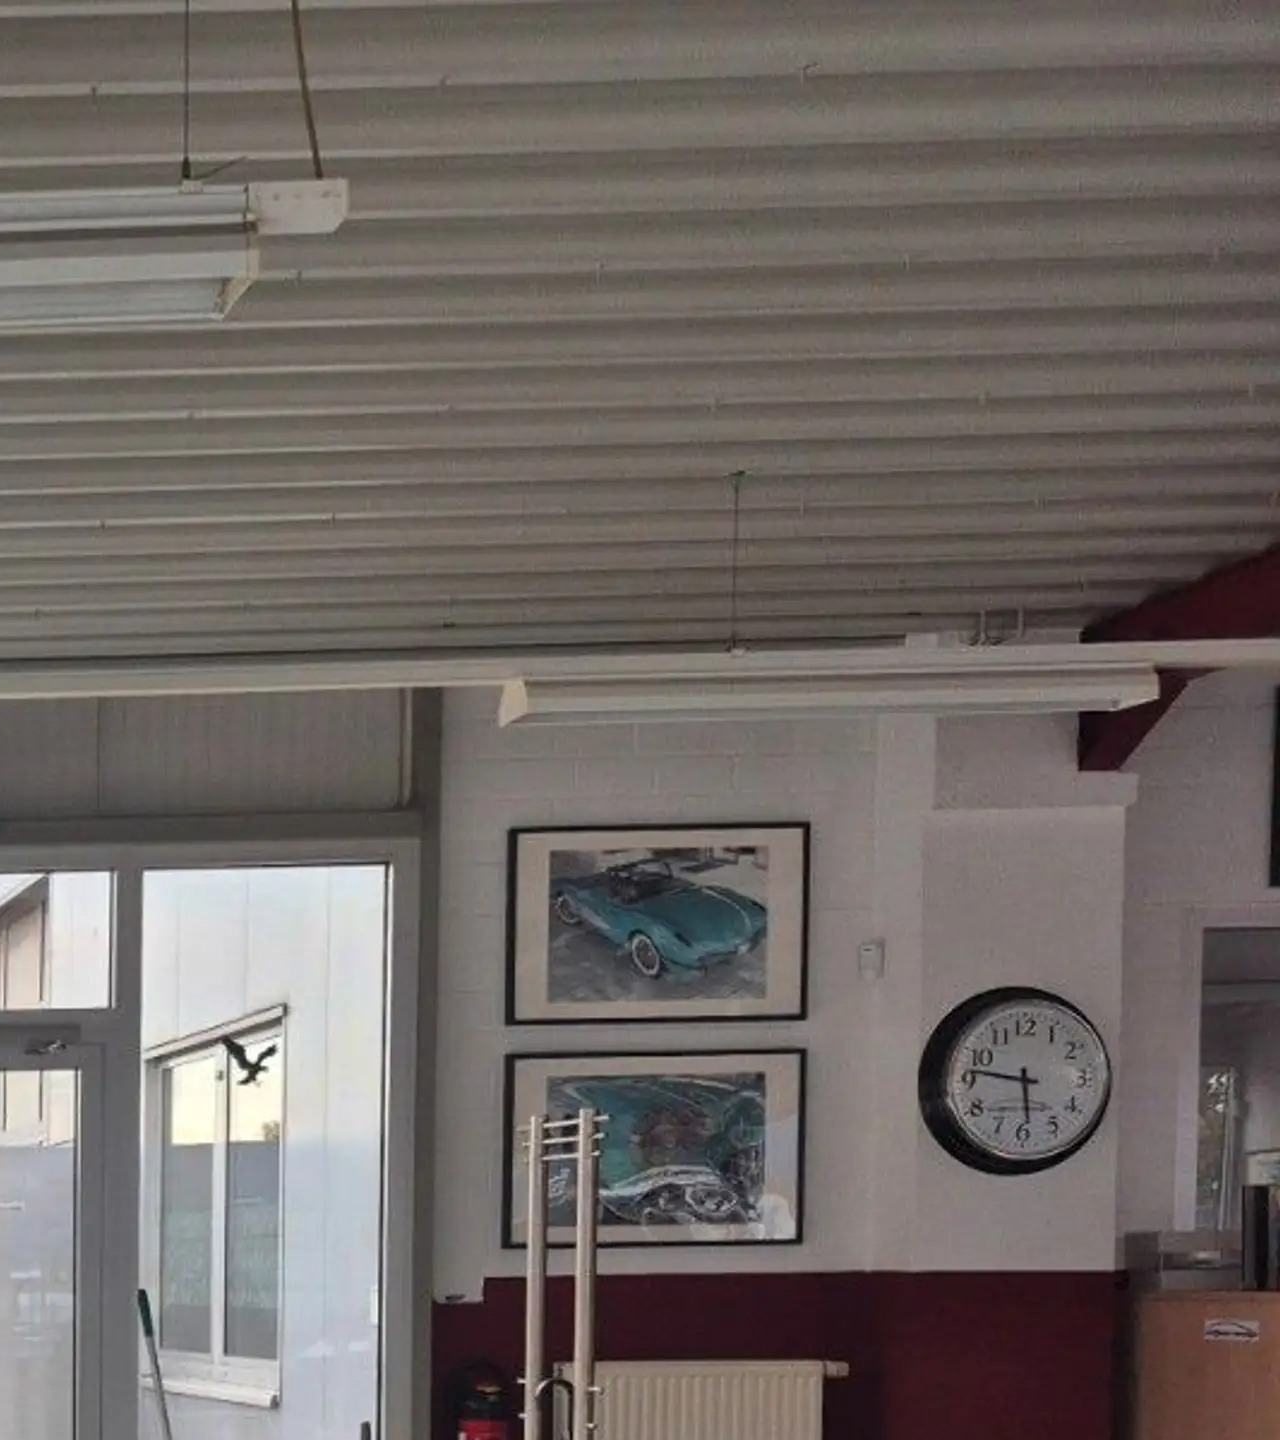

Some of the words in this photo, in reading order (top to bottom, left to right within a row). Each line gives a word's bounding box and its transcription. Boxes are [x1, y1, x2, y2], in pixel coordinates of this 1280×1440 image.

[993, 1028, 1008, 1045] 11
[1015, 1020, 1037, 1036] 12
[1048, 1025, 1055, 1044] 1
[971, 1049, 993, 1067] 10
[1065, 1042, 1077, 1060] 2
[961, 1071, 976, 1090] 9
[970, 1099, 984, 1117] 8
[992, 1116, 1005, 1135] 7
[1016, 1122, 1030, 1142] 6
[1047, 1116, 1058, 1138] 5
